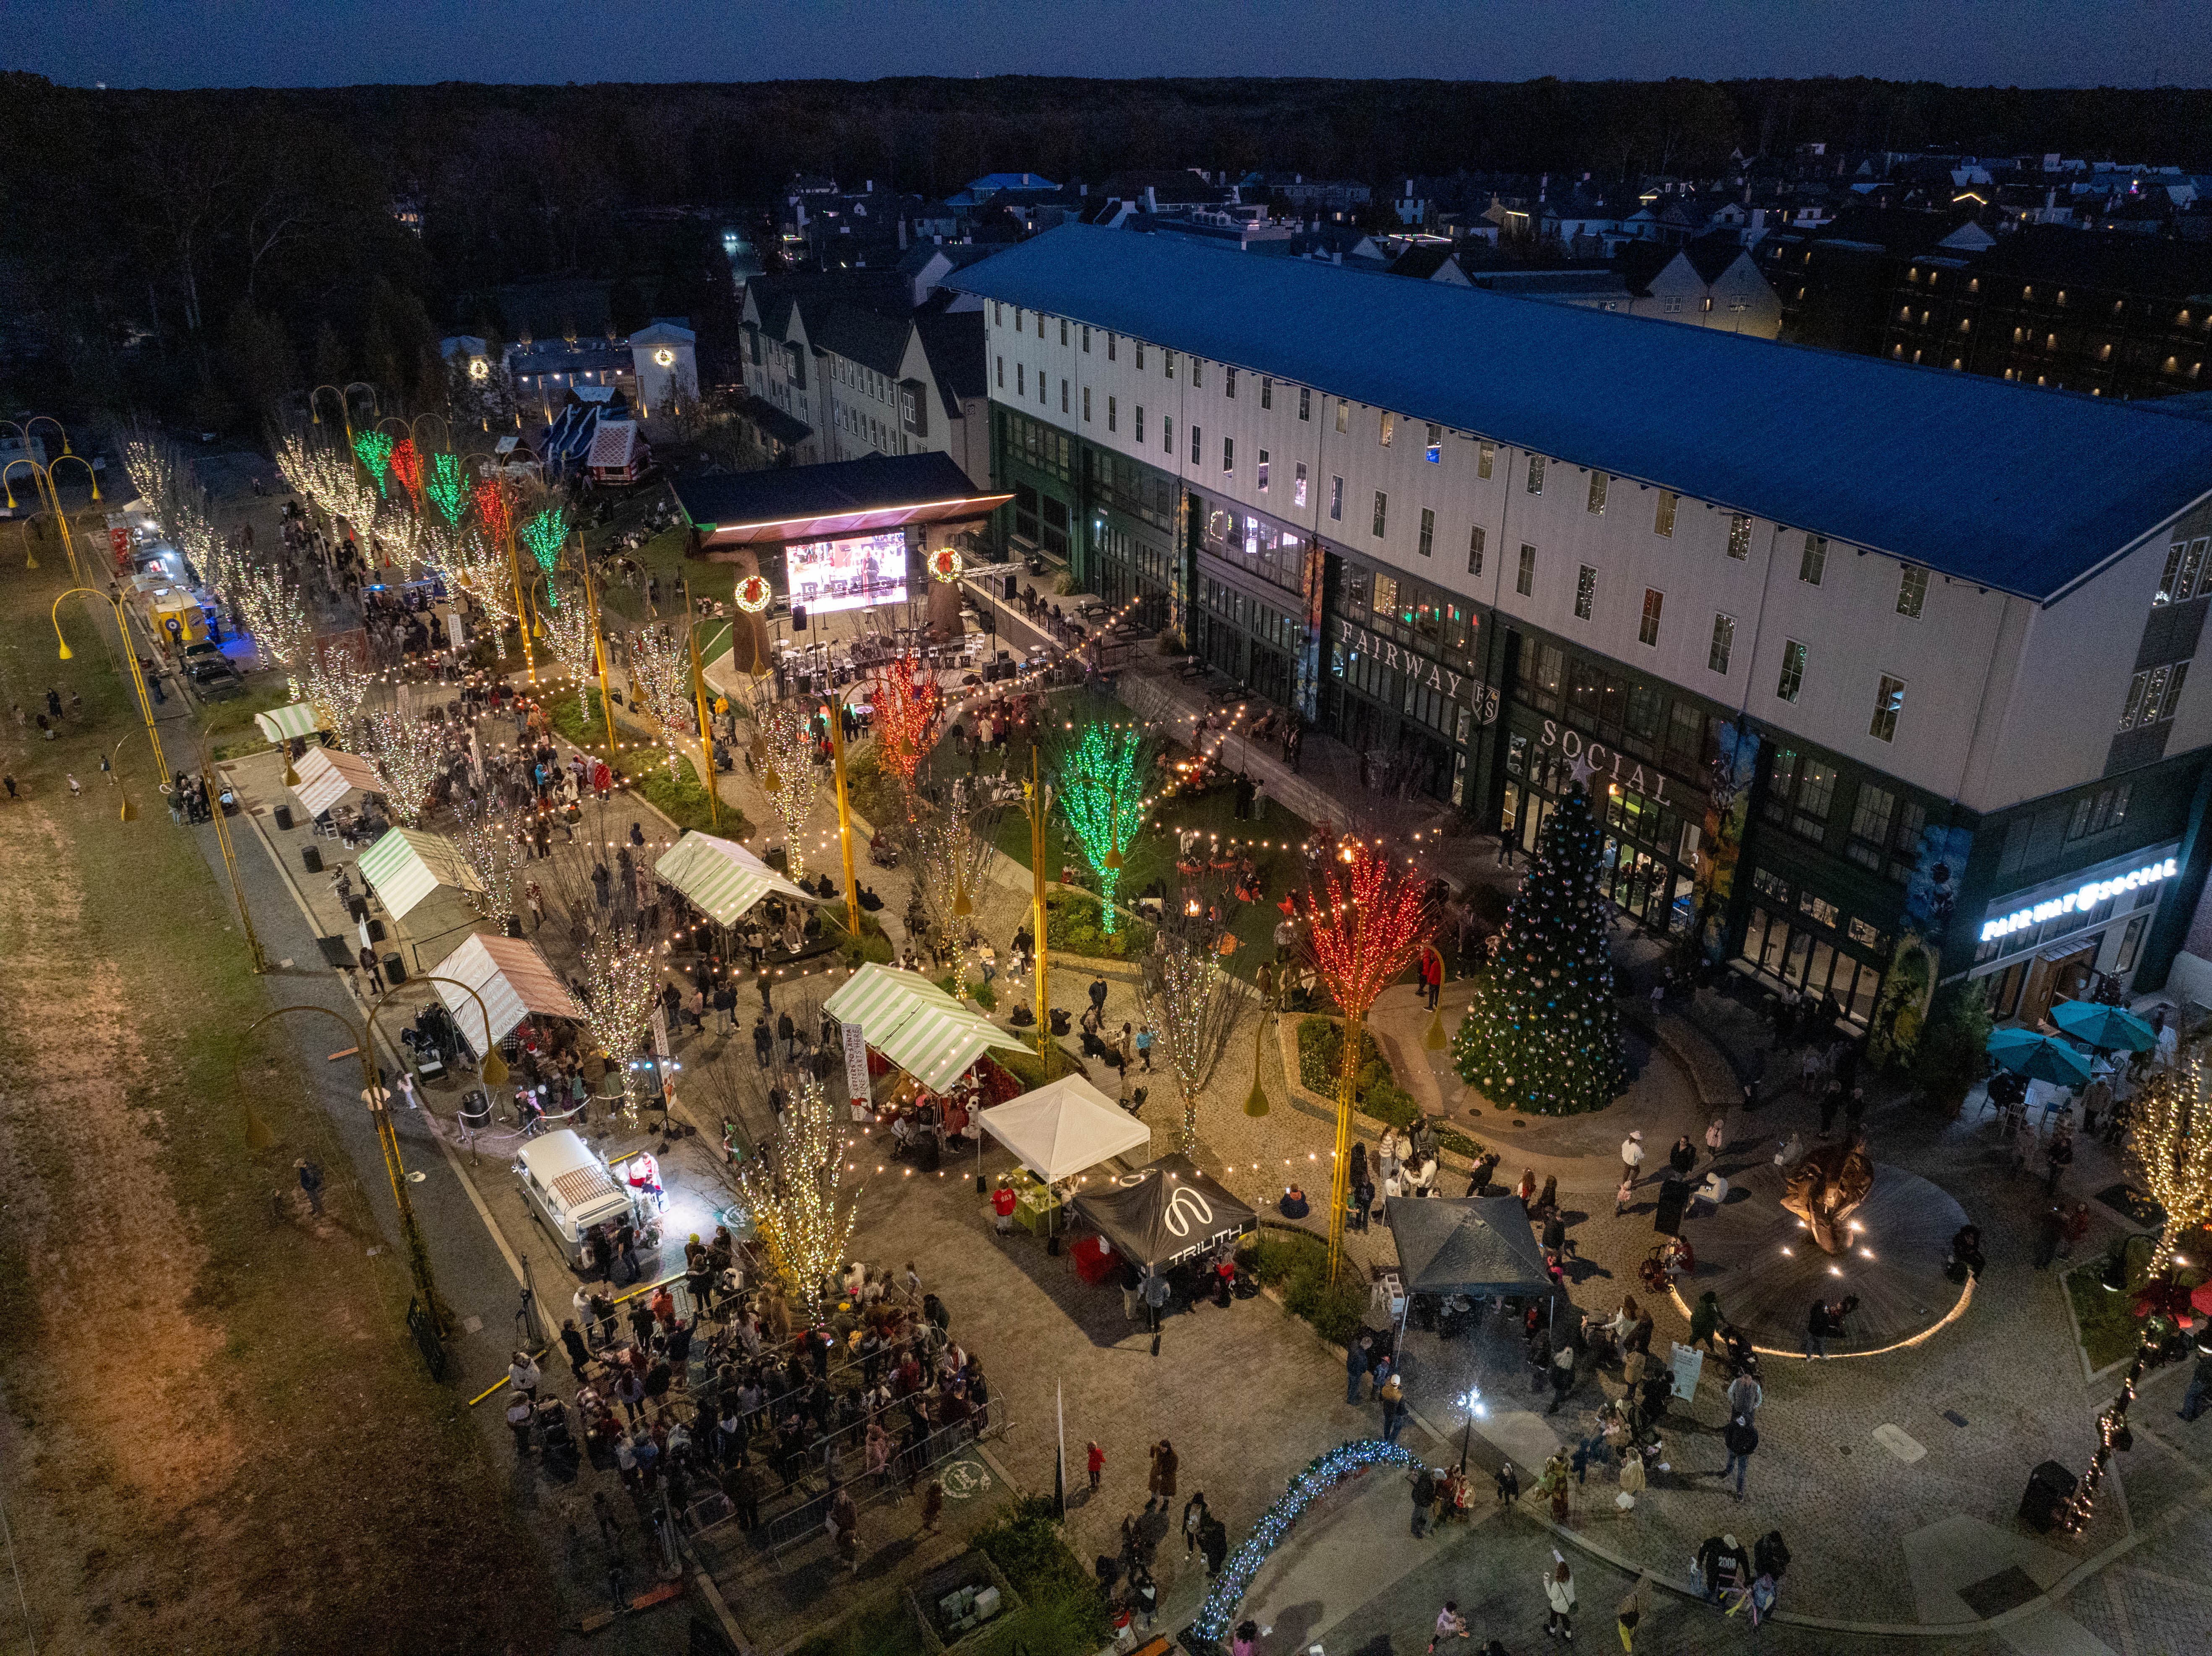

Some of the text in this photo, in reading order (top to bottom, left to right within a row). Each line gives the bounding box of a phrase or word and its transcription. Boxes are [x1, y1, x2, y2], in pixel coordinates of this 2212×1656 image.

[1341, 620, 1462, 698] FAIRWAY
[1541, 719, 1671, 807] SOCIAL
[1980, 857, 2177, 941] FAIRWAY SOCIAL
[849, 1054, 854, 1062] TO
[850, 1064, 858, 1091] LETTERS
[1169, 1224, 1242, 1265] TRILITH
